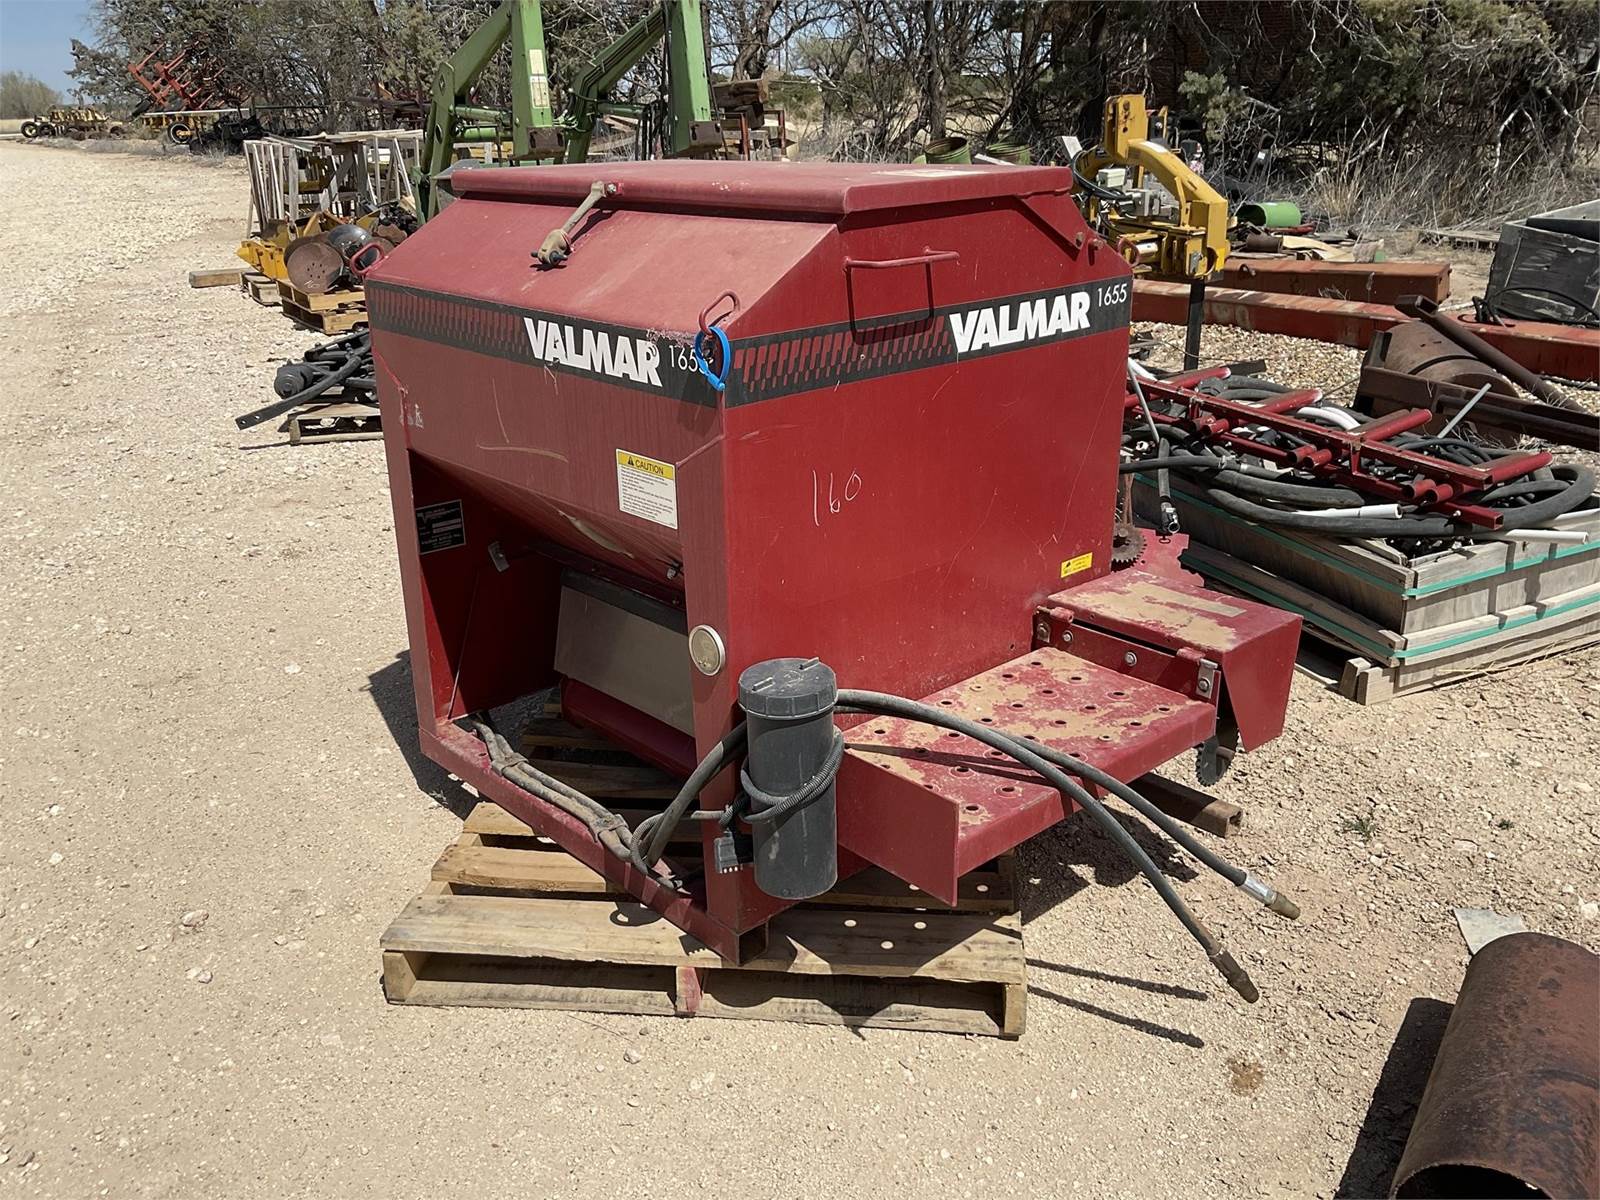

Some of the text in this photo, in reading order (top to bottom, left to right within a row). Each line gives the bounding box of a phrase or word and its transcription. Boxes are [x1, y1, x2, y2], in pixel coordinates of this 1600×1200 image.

[949, 284, 1127, 353] VALMAR 1655
[524, 317, 708, 387] VALMAR 165
[635, 459, 664, 475] CAUTION
[812, 469, 862, 526] 160
